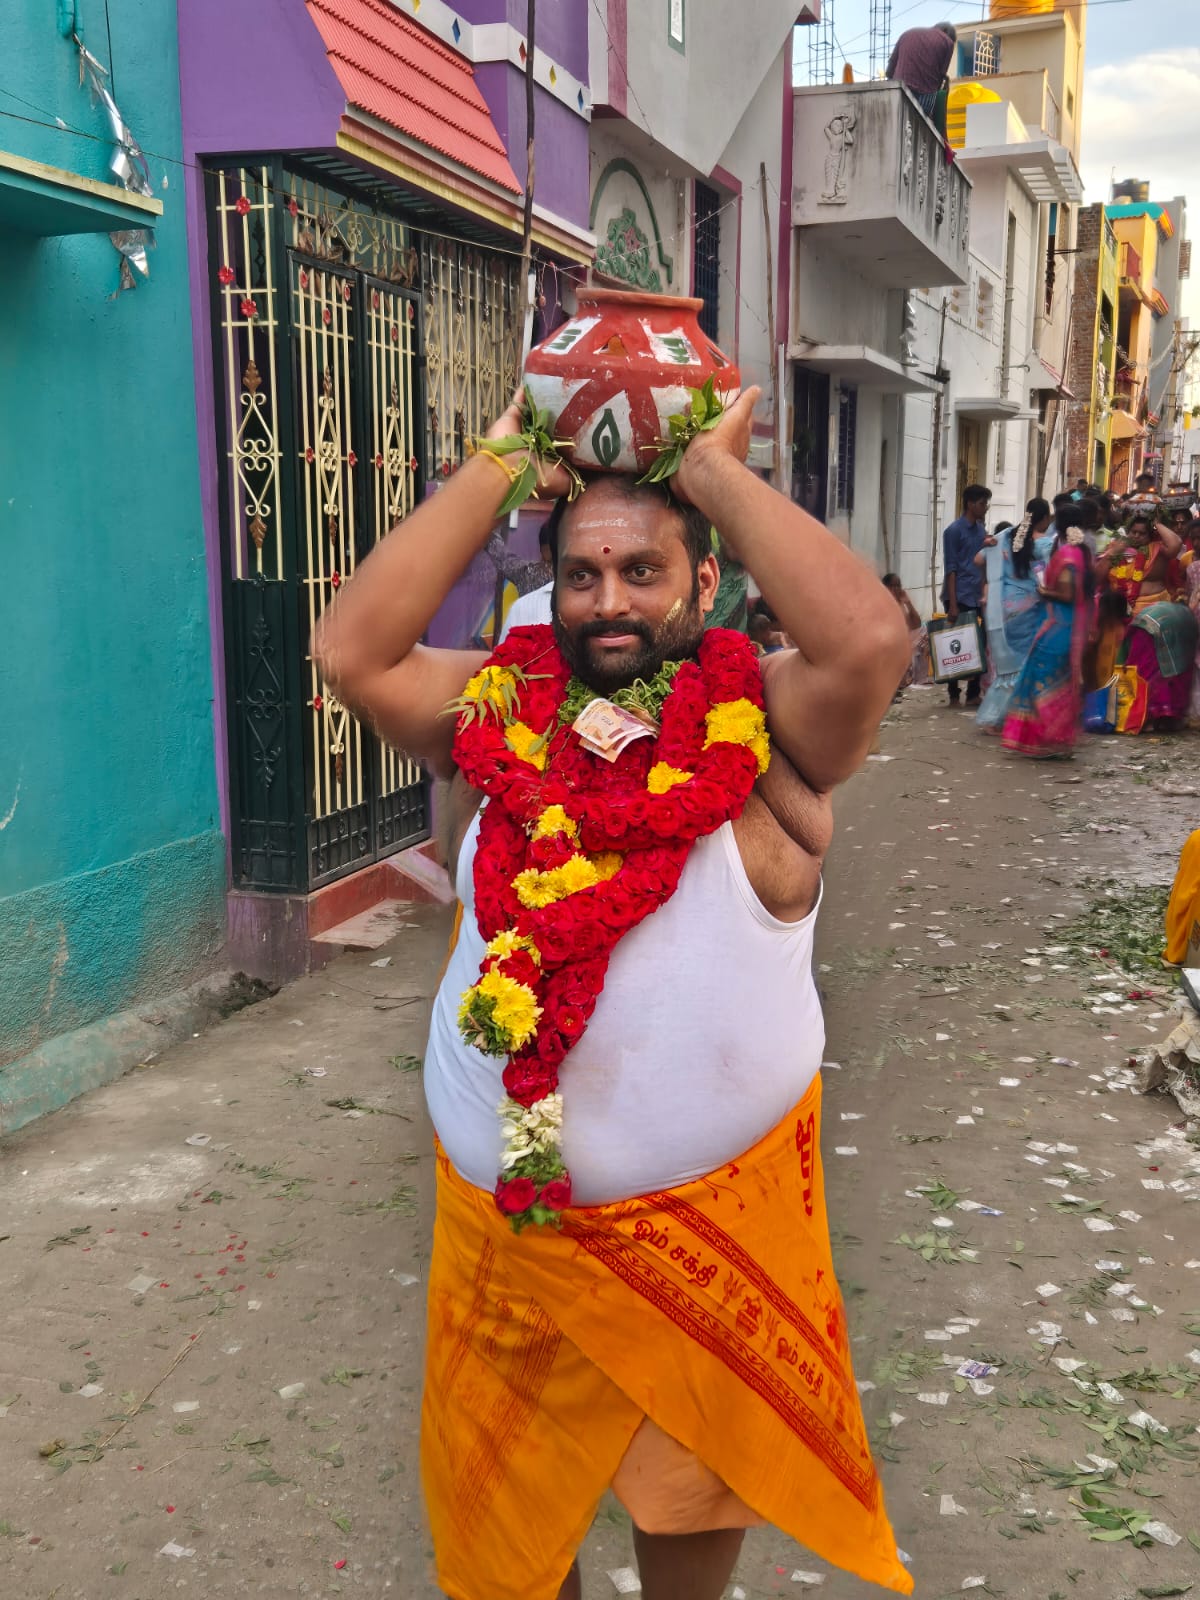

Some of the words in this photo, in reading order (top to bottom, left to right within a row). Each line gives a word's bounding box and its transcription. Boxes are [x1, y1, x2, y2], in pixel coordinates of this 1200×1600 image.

[632, 1219, 669, 1250] ஓம்
[669, 1246, 718, 1288] சக்தி
[798, 1360, 824, 1398] சக்தி
